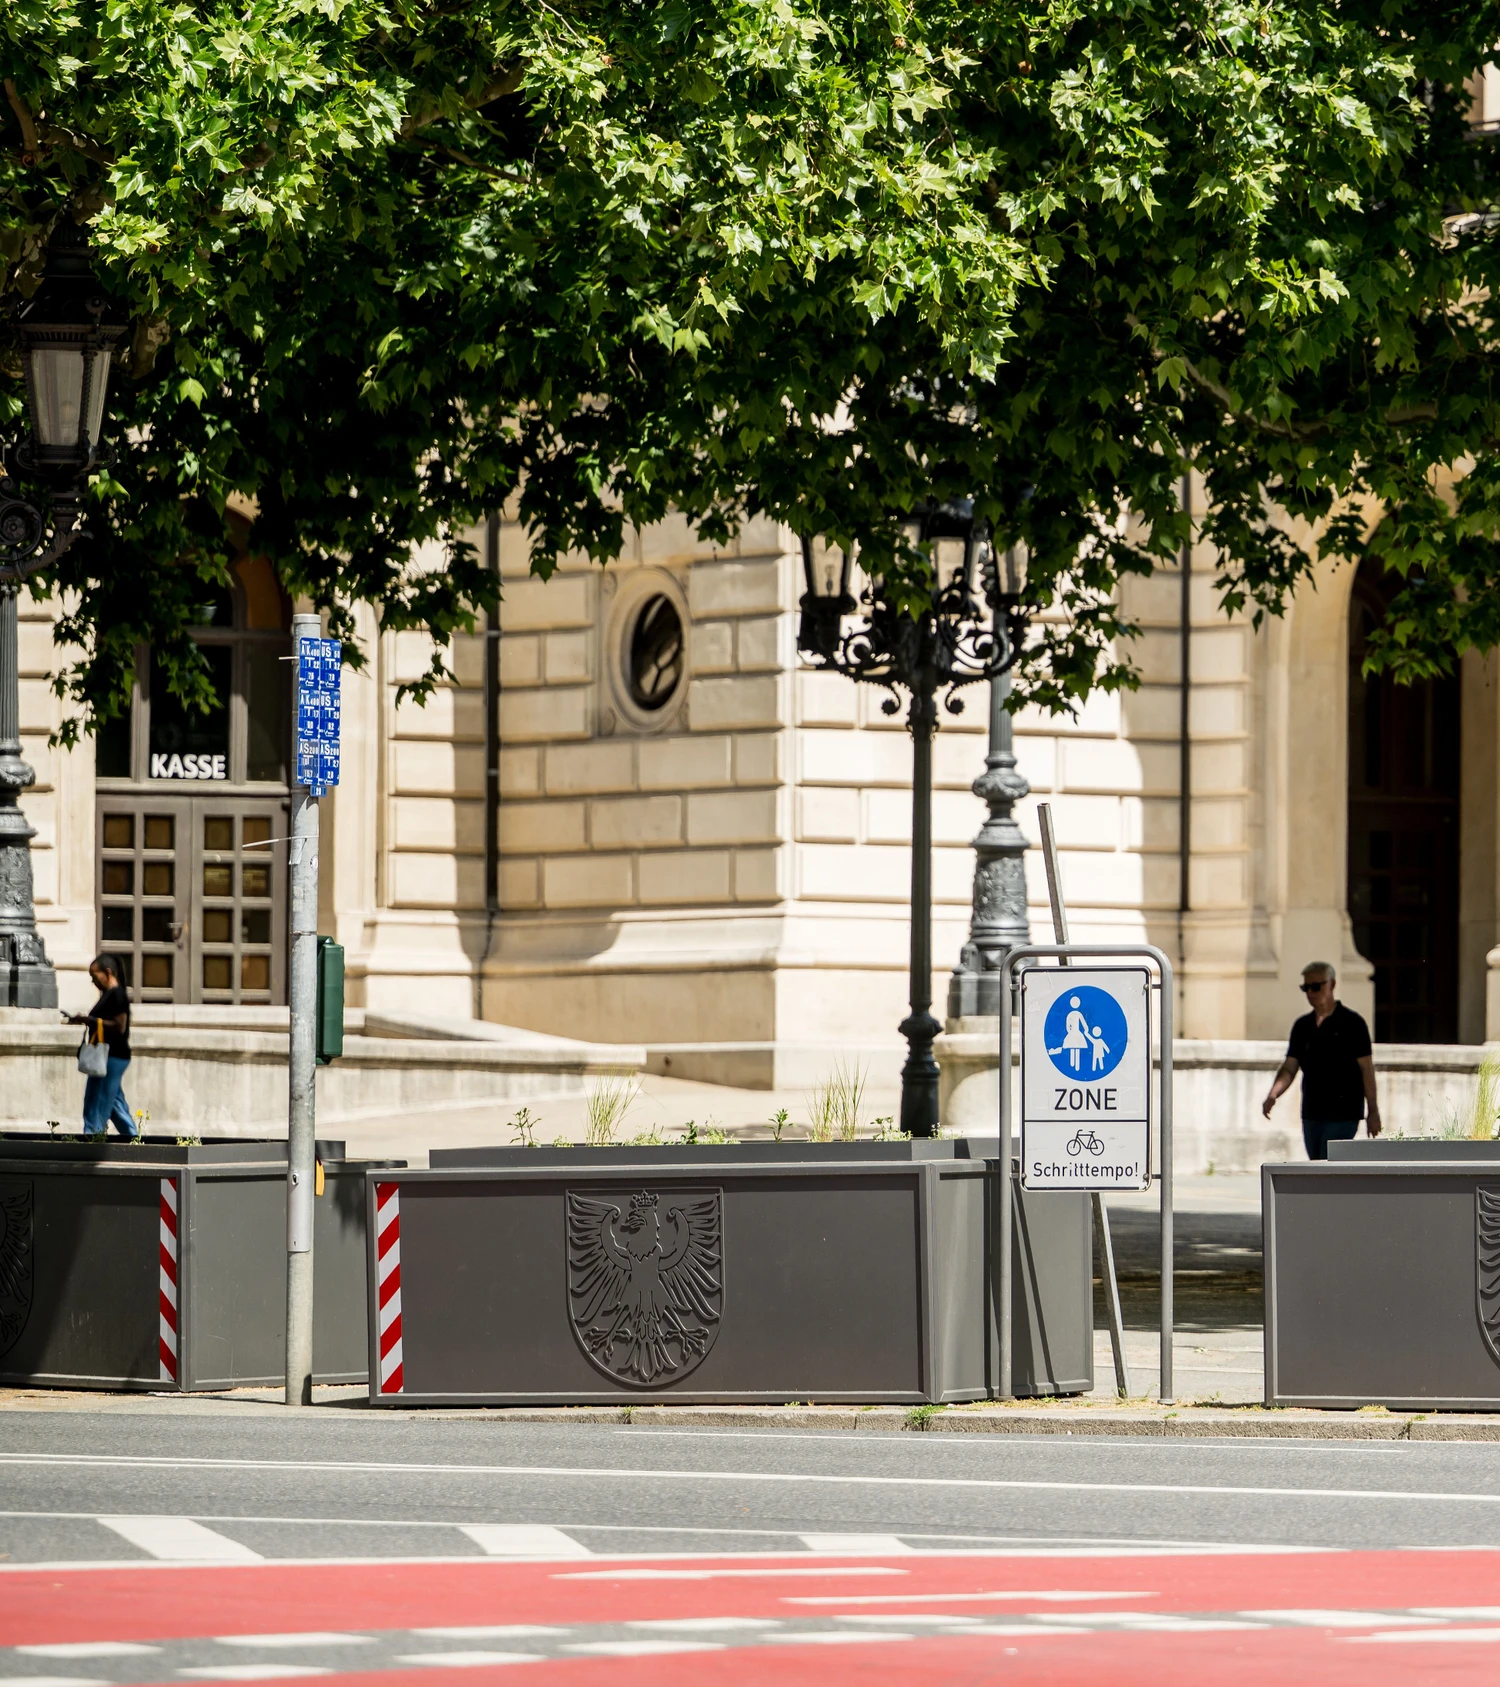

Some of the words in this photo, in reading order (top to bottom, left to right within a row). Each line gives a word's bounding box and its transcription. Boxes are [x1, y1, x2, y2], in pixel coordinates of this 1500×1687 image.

[151, 753, 226, 779] KASSE
[1054, 1088, 1117, 1111] ZONE
[1033, 1161, 1138, 1181] Schritttempo!
